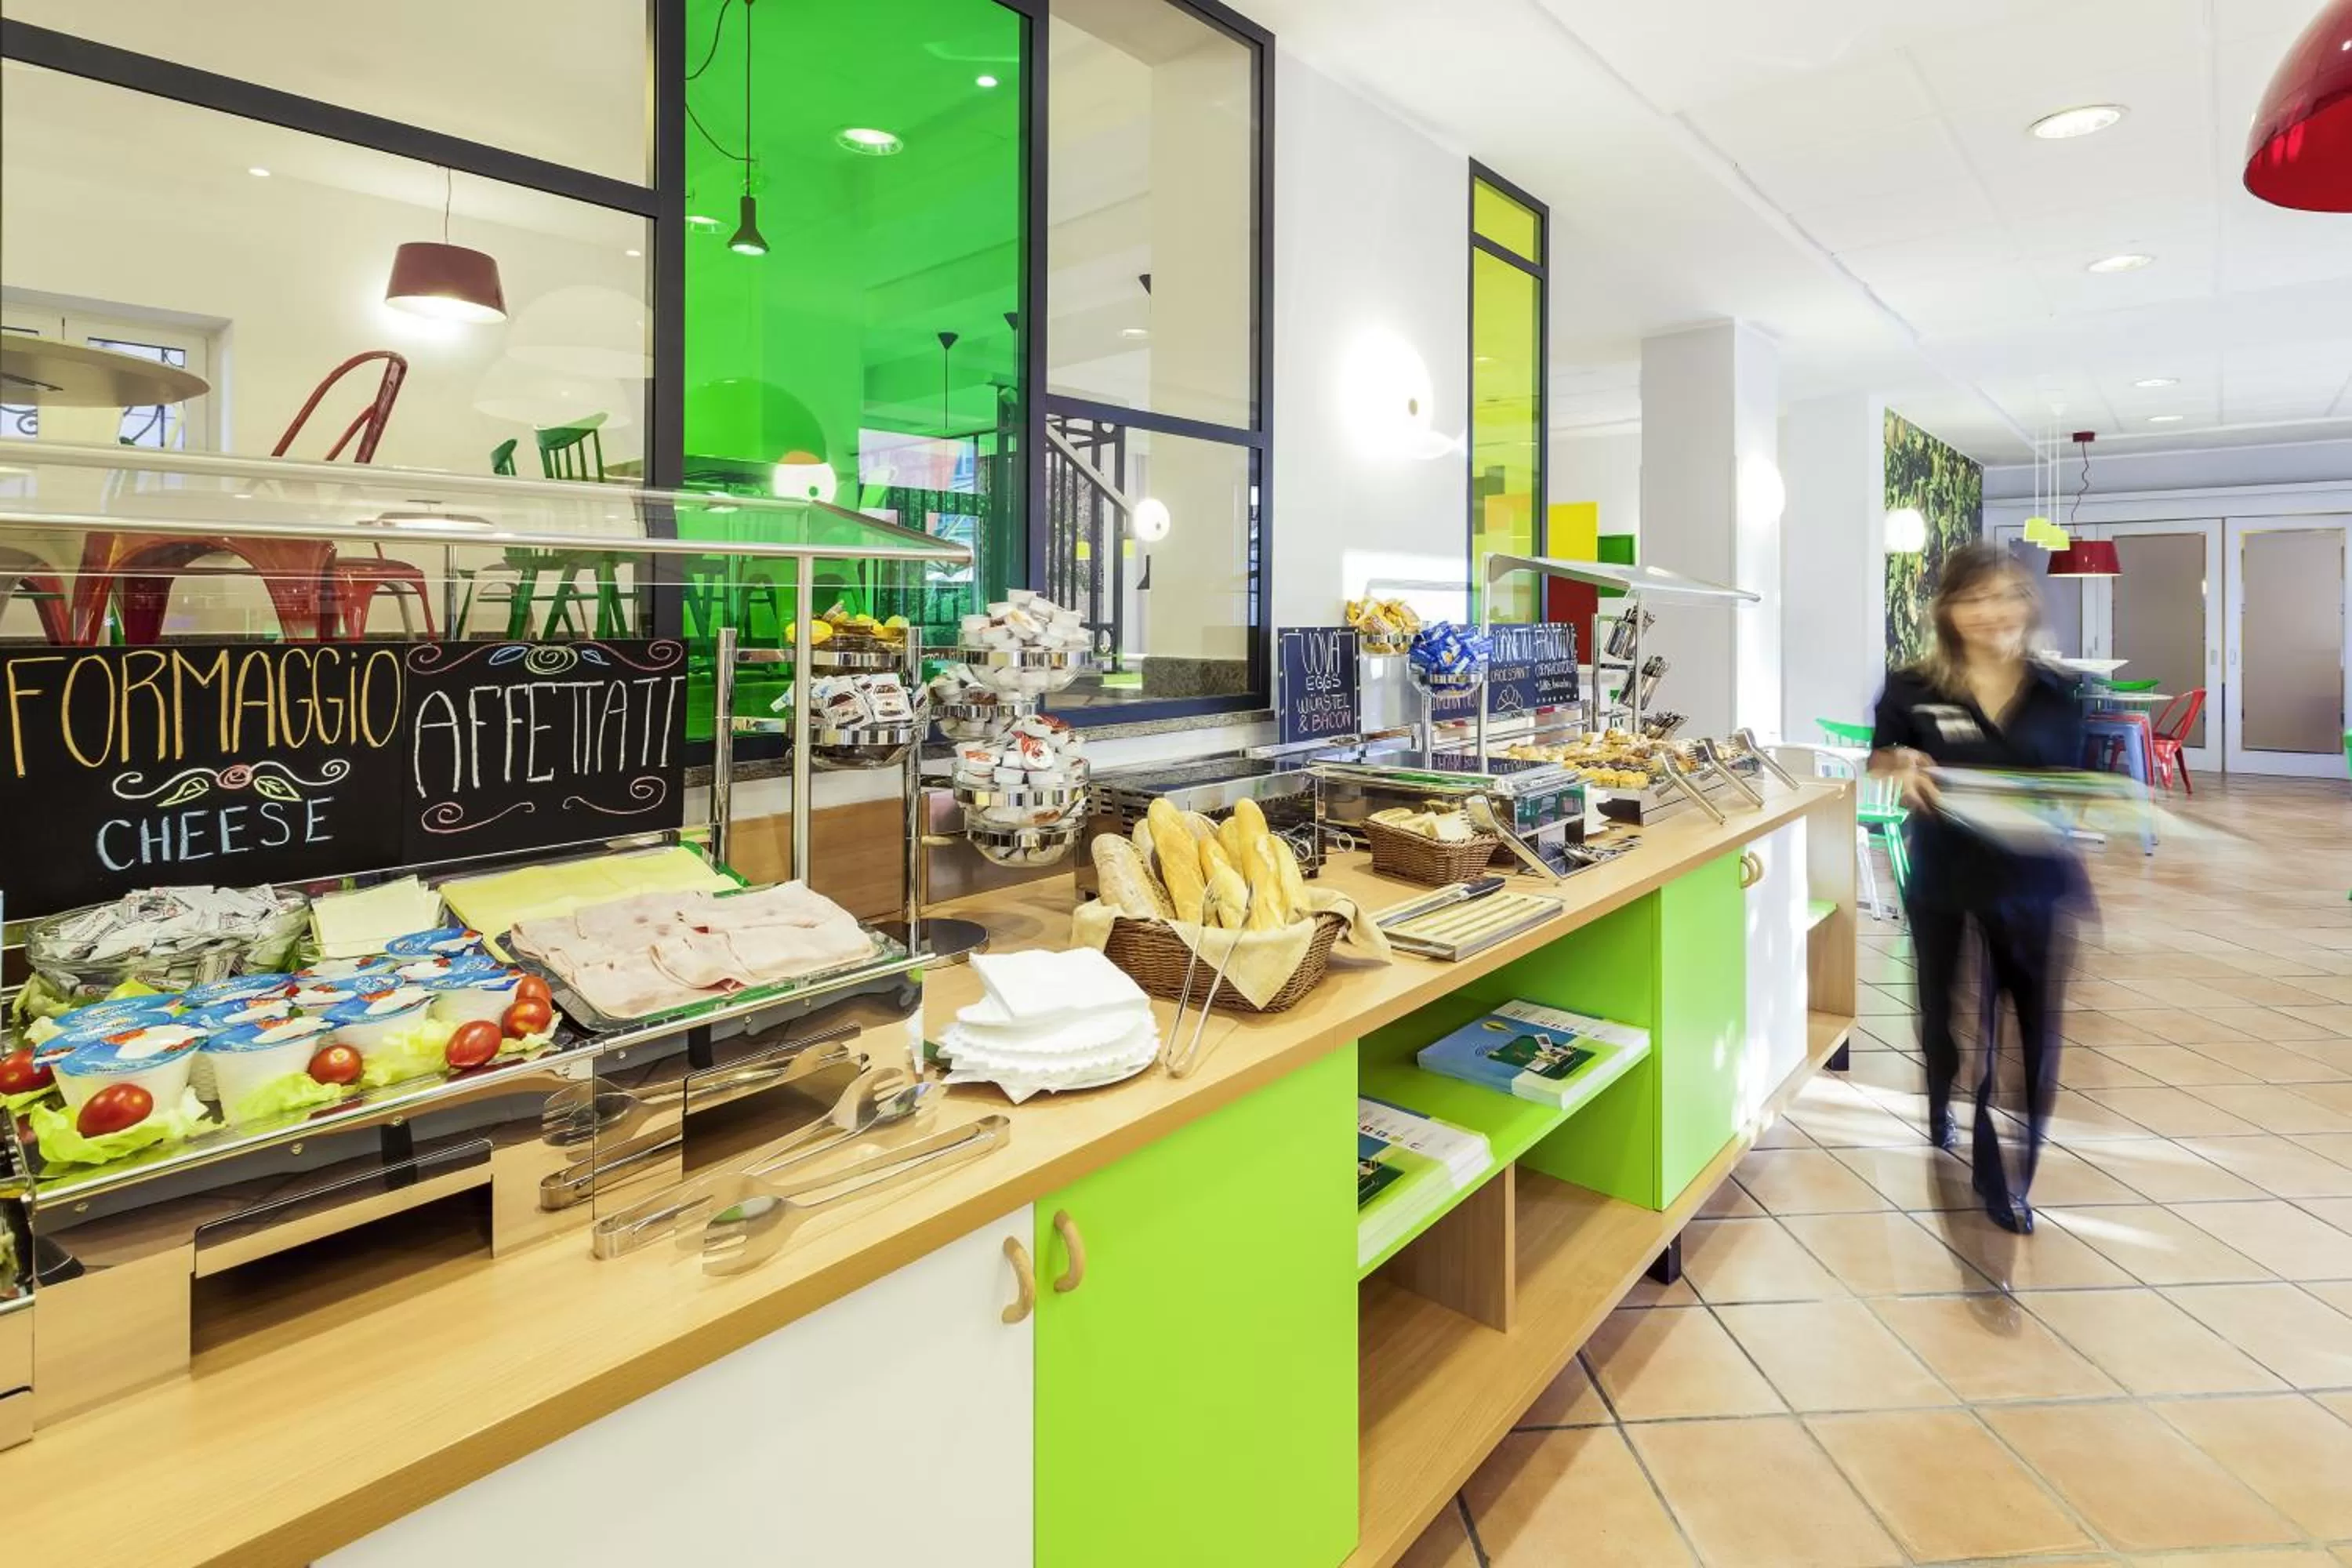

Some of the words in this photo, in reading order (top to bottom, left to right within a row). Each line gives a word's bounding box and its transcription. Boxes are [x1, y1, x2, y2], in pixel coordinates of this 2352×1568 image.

[1305, 675, 1341, 693] EGGS
[413, 675, 686, 798] AFFETTATI
[1298, 714, 1308, 734] &
[1312, 710, 1351, 731] BACON
[96, 797, 336, 871] CHEESE
